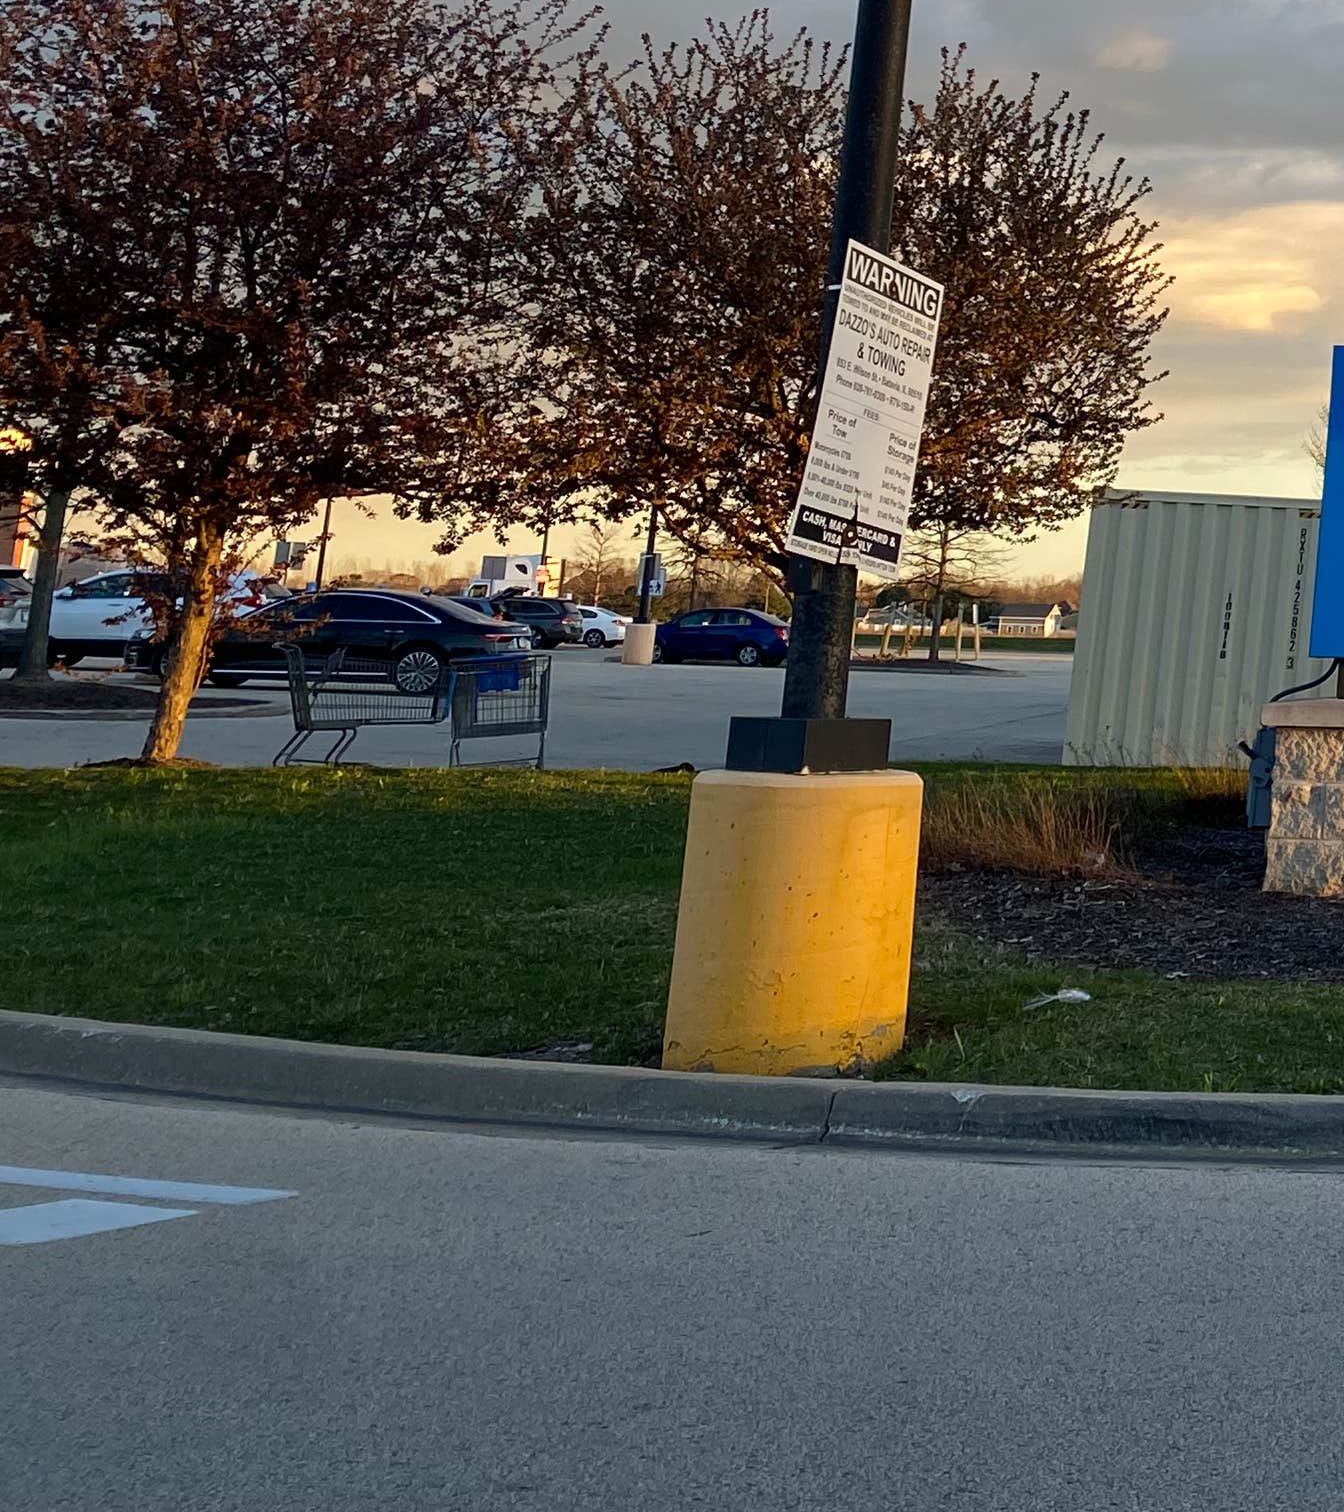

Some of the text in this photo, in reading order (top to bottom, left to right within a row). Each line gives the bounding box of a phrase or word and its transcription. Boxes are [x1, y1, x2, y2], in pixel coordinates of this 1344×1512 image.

[852, 251, 937, 316] WARNING
[839, 308, 931, 363] DAZZO'S AUTO REPAIR
[857, 342, 906, 377] & TOWING
[827, 409, 857, 428] Price of
[832, 424, 848, 438] Tow
[887, 445, 915, 465] Storage
[889, 432, 917, 451] Price of
[802, 511, 896, 547] CASH, MASERCARD &
[822, 530, 842, 546] VISA
[1289, 580, 1300, 652] 425862
